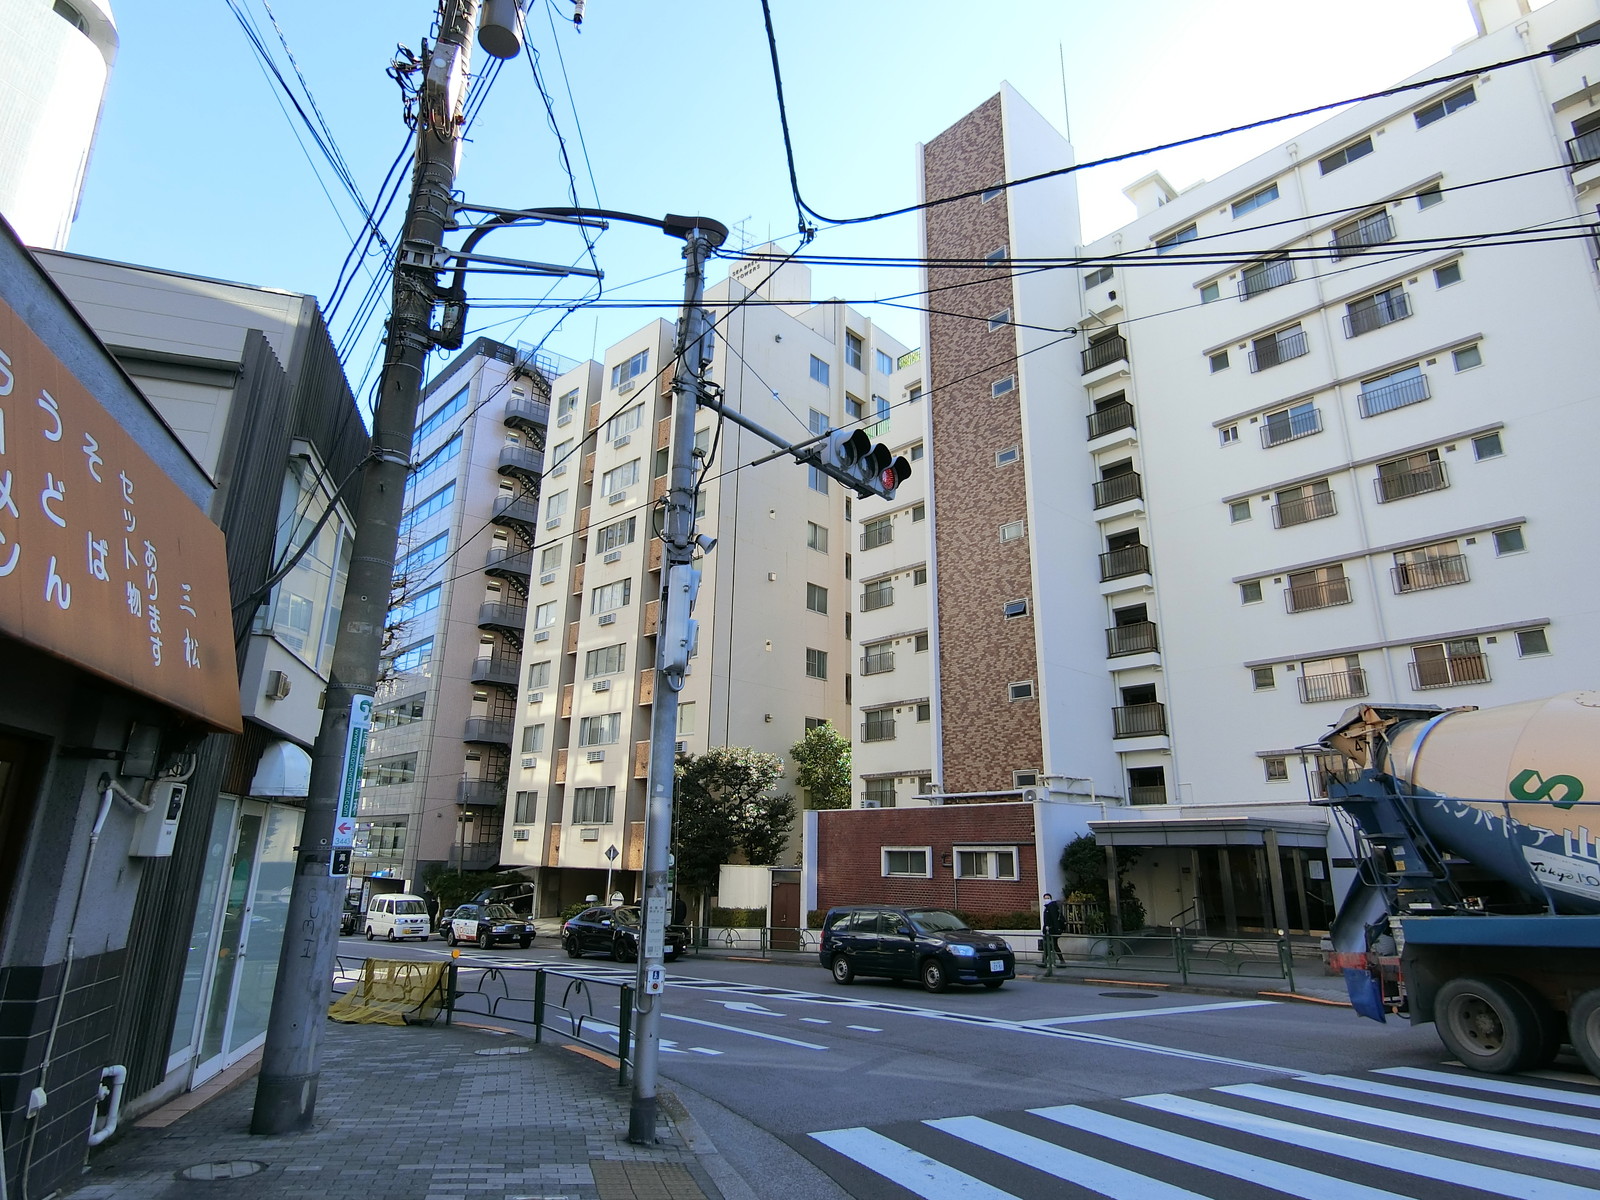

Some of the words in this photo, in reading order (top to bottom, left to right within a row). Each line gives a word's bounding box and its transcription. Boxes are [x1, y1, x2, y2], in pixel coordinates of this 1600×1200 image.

[732, 268, 743, 277] SEA
[737, 264, 761, 280] TOWERS
[38, 389, 71, 610] うどん
[82, 432, 110, 582] そば
[119, 469, 142, 618] セット物
[144, 540, 163, 667] あります
[342, 728, 361, 817] www.takanawadent.com
[1530, 862, 1574, 882] Tokyo
